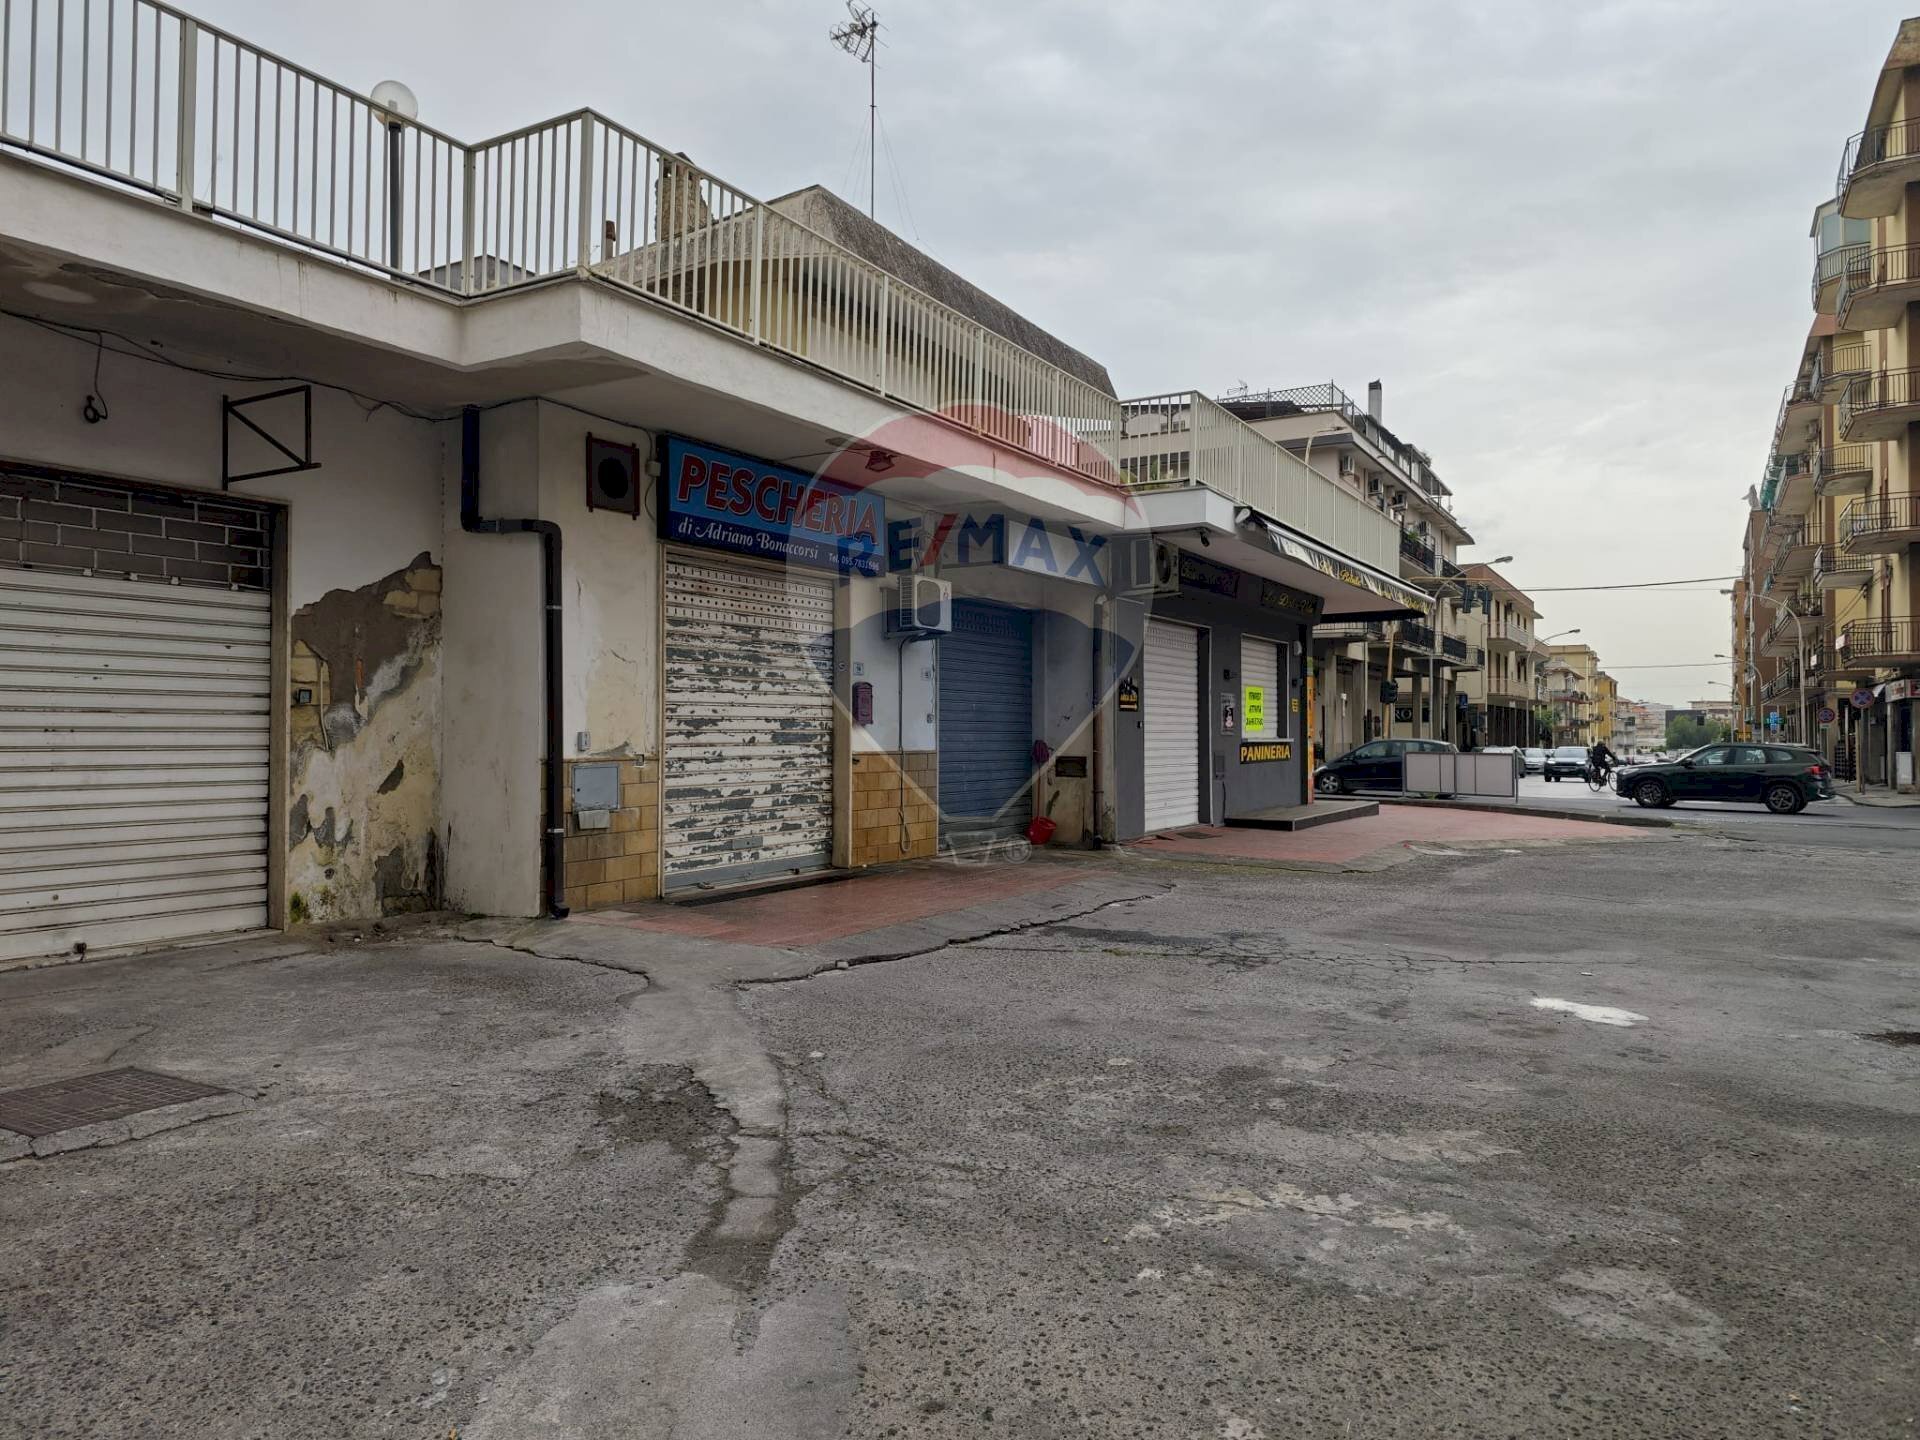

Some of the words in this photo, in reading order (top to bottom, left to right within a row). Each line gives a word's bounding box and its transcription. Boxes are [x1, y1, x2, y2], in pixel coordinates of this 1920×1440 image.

[677, 452, 878, 545] PESCHERIA
[678, 516, 692, 535] di
[695, 521, 753, 546] Adriano
[756, 532, 819, 560] Bonaccorsi
[1241, 744, 1291, 763] PANINERIA
